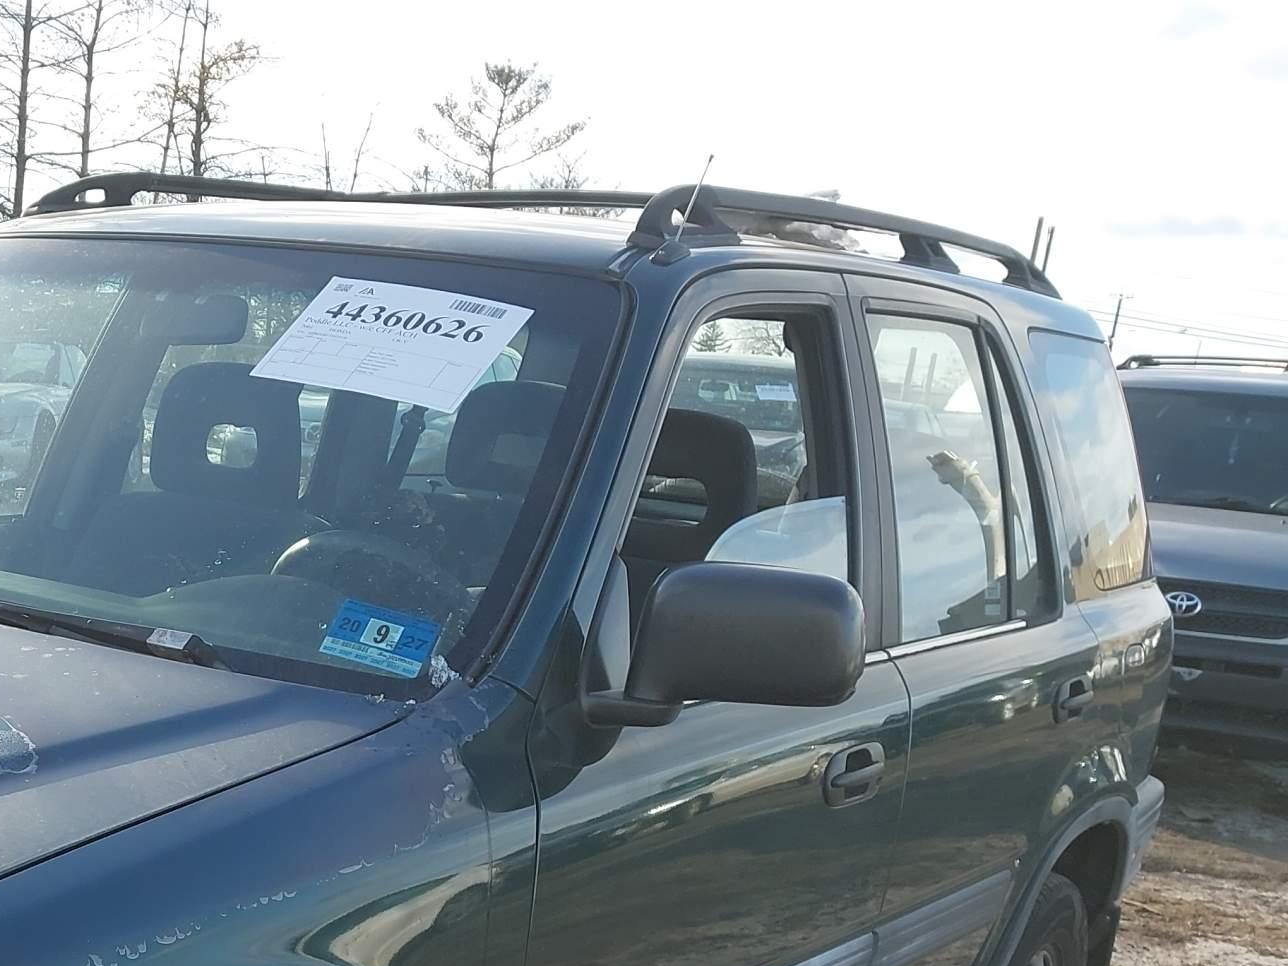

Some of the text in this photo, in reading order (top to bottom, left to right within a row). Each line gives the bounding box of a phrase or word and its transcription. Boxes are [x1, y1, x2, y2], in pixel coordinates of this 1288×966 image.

[324, 301, 492, 343] 44360626
[339, 616, 361, 633] 20
[373, 624, 391, 644] 9
[402, 635, 429, 650] 27
